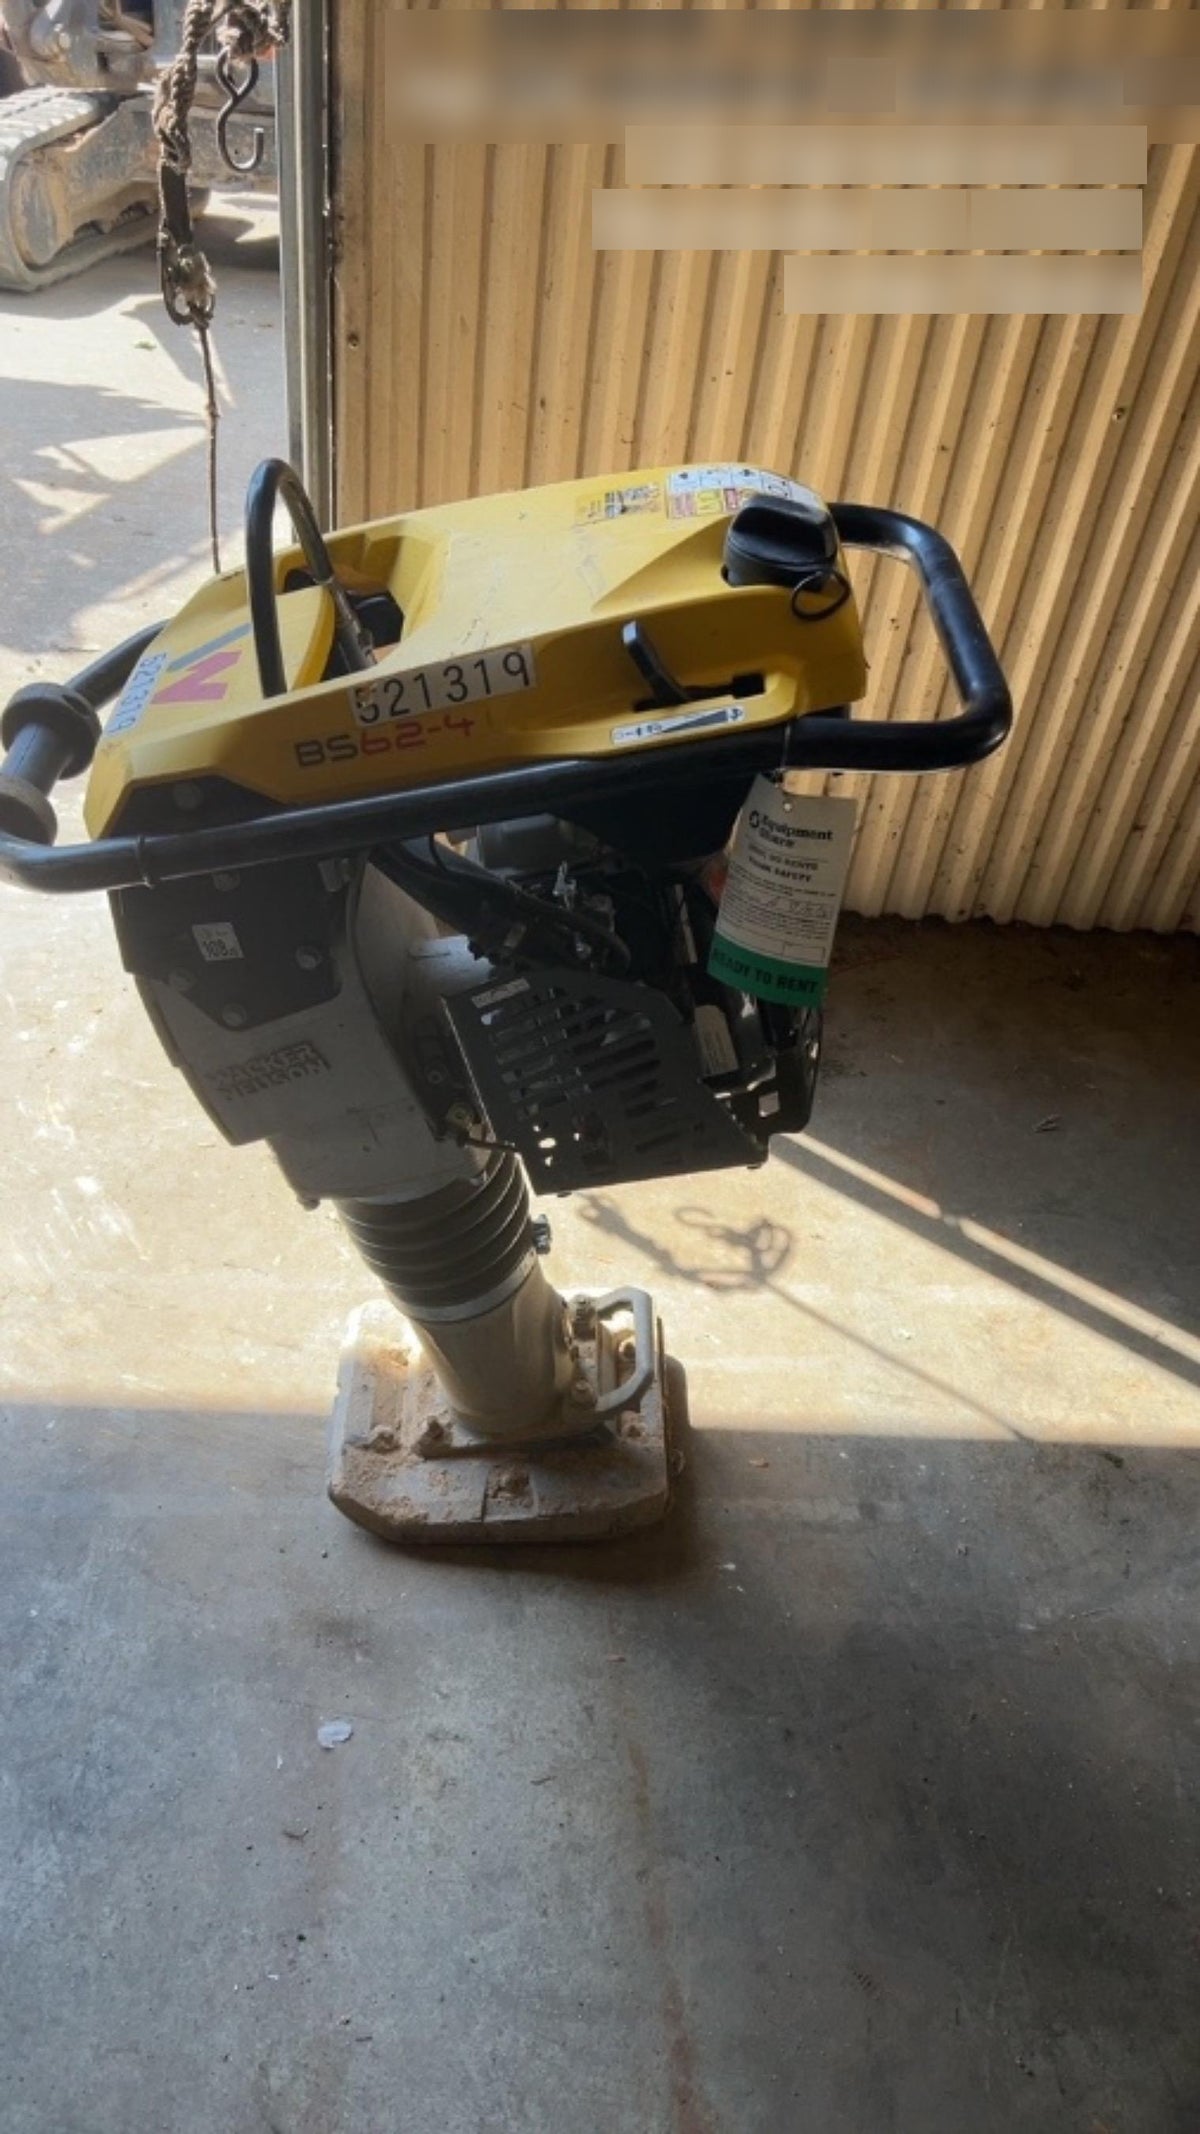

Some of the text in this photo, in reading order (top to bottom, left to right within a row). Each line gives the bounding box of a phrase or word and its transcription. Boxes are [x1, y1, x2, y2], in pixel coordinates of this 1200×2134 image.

[354, 651, 530, 723] 521319
[295, 716, 475, 766] BS62-4
[761, 814, 834, 841] Equipment
[755, 967, 772, 985] TO
[776, 971, 819, 994] RENT
